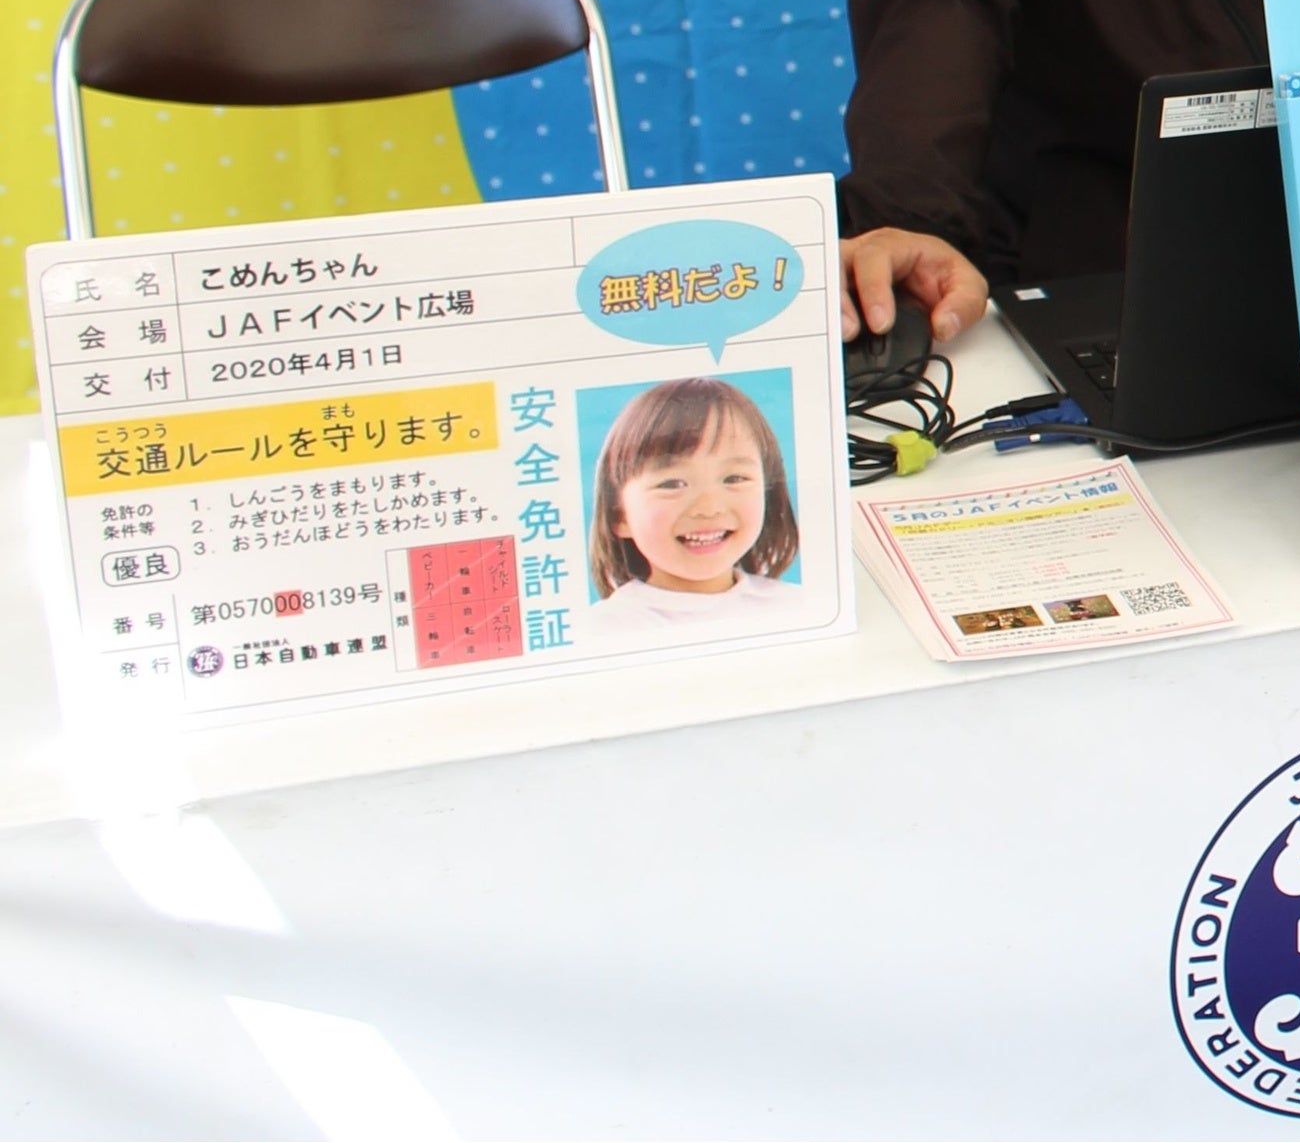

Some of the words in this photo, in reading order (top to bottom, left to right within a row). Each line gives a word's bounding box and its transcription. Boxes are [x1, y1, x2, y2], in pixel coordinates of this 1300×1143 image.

[201, 253, 378, 290] こめんちゃん
[599, 257, 787, 315] 無料だよ!
[207, 290, 475, 338] JAFイベント広場
[211, 345, 402, 382] 2020年4月1日
[322, 404, 355, 420] まも
[96, 423, 167, 444] こうつう
[97, 411, 480, 479] 交通ルールを守ります。
[229, 471, 437, 508] しんごうをまもります。
[229, 487, 478, 529] みぎひだりをたしかめます。
[233, 506, 498, 552] おうだんほどうをわたります。
[510, 385, 573, 651] 安全免許証
[112, 554, 170, 581] 優良
[191, 583, 382, 625] 第0570008139号
